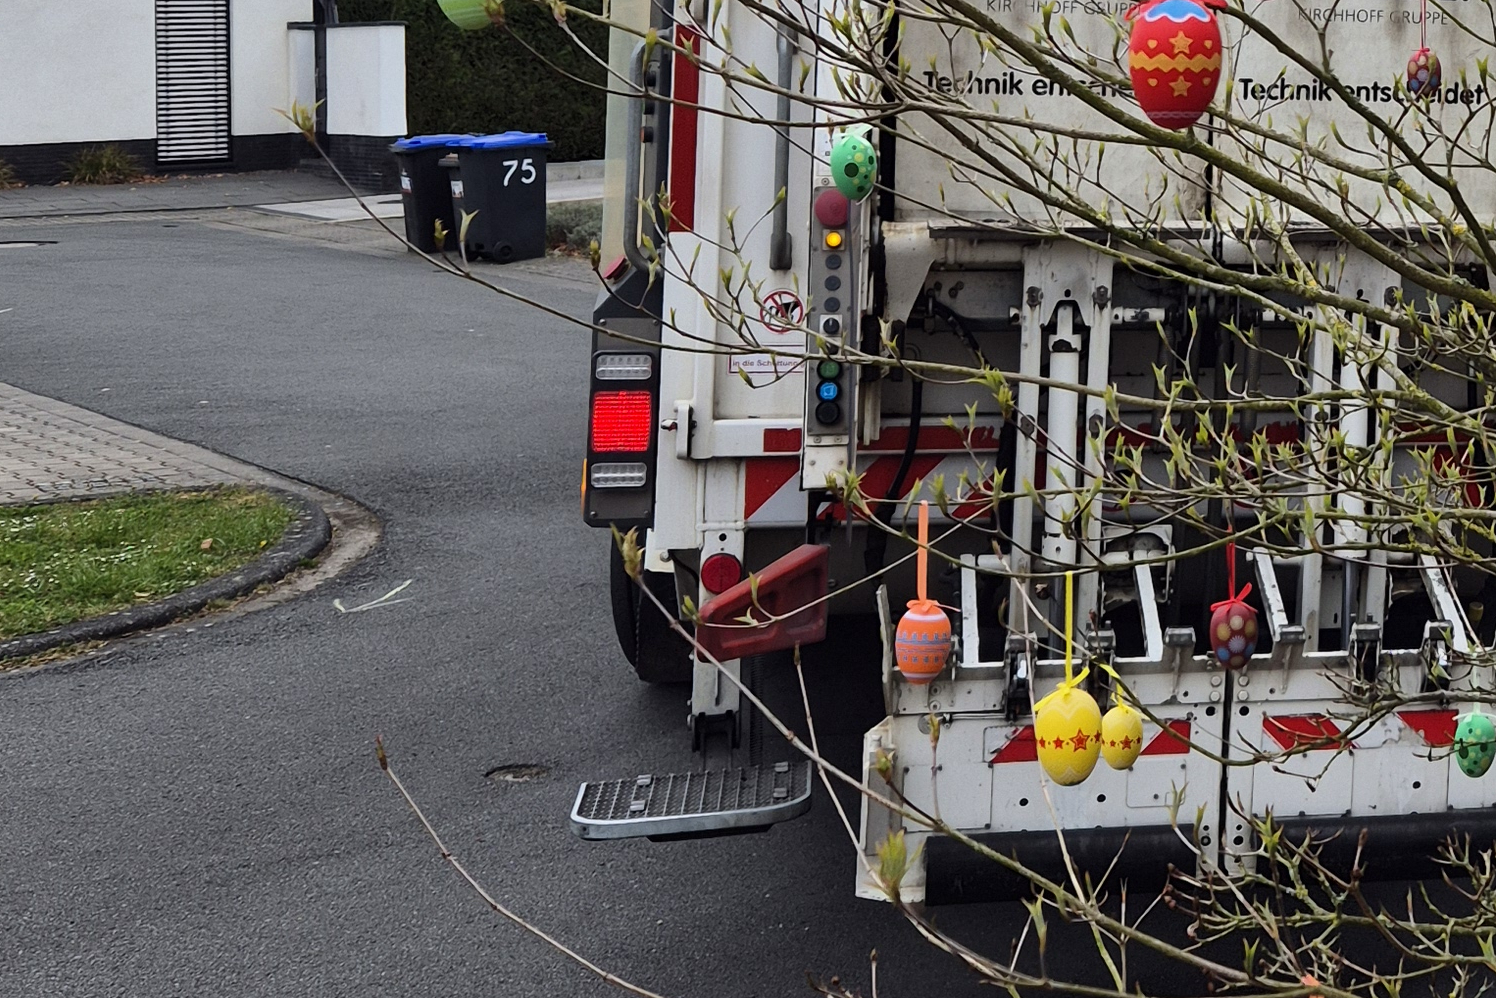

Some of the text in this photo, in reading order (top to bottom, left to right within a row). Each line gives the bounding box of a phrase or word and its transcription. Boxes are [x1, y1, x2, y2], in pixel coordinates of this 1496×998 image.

[1083, 0, 1142, 15] GRUPP
[1298, 8, 1449, 25] KIRCHHOFF GRUPPE
[922, 70, 1024, 96] Tehnik
[1238, 77, 1333, 102] Technik
[503, 158, 537, 187] 75
[741, 359, 755, 367] die
[756, 359, 805, 369] Schttun
